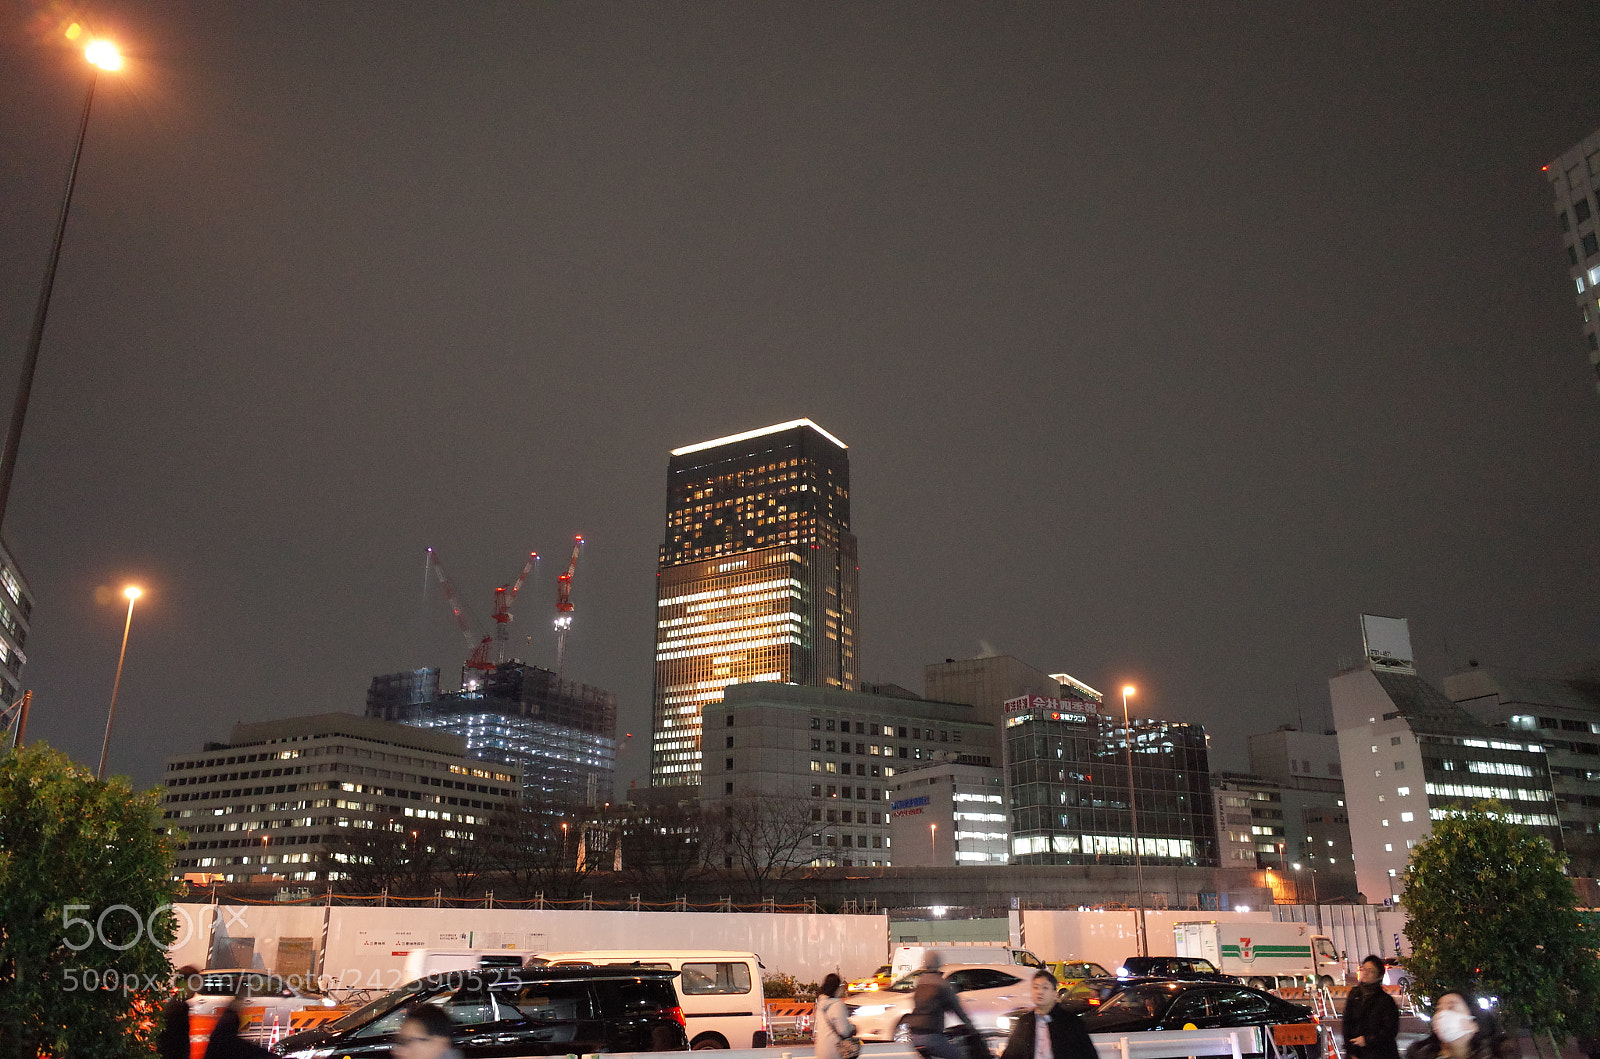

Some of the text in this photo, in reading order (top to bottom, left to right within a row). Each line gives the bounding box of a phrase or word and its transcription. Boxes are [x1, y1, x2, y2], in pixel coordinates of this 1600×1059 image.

[1033, 697, 1097, 713] 会社四季報
